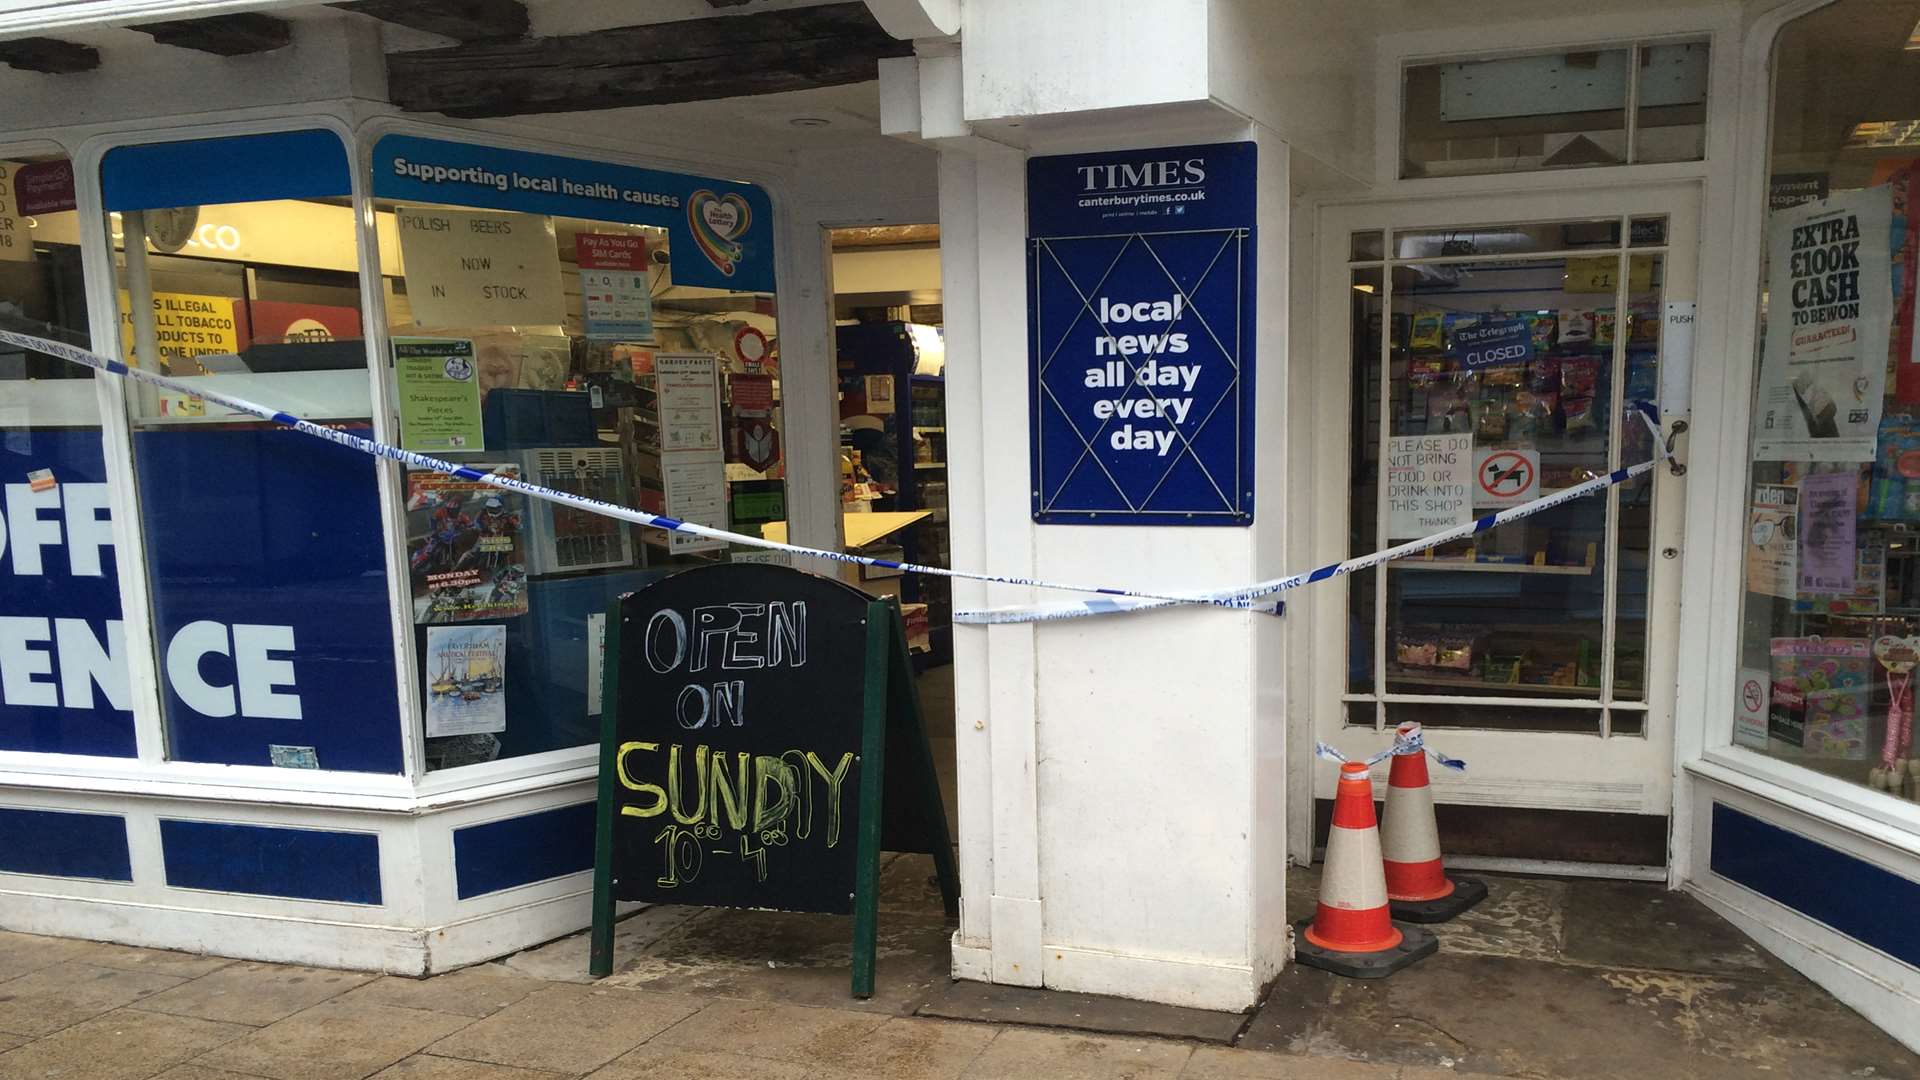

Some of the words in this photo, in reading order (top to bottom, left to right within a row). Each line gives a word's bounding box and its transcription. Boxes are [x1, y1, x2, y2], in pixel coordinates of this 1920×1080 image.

[394, 158, 508, 191] Supporting
[513, 172, 557, 194] local
[562, 179, 618, 201] health
[623, 189, 679, 208] causes
[1078, 158, 1206, 191] TIMES
[1078, 190, 1206, 208] canterburytimes.co.uk
[709, 218, 734, 228] Lottery
[710, 211, 733, 219] Health
[399, 216, 451, 234] POLISH
[470, 218, 511, 235] BEERS
[1791, 214, 1860, 251] EXTRA
[582, 237, 598, 249] Pay
[599, 238, 609, 247] As
[610, 238, 626, 248] You
[627, 240, 639, 248] Go
[608, 249, 633, 259] Cards
[1790, 241, 1860, 280] £100K
[461, 256, 491, 272] NOW
[431, 284, 446, 299] IN
[483, 285, 528, 300] STOCK
[1791, 269, 1860, 309] CASH
[165, 299, 217, 313] ILLEGAL
[1100, 293, 1183, 323] local
[1792, 309, 1811, 326] TO
[1811, 307, 1825, 324] BE
[1825, 303, 1860, 322] WON
[176, 315, 232, 330] TOBACCO
[1670, 314, 1696, 324] PUSH
[156, 330, 205, 343] ODUCTS
[207, 333, 222, 344] TO
[1458, 331, 1478, 342] The
[1480, 321, 1525, 338] Telegraph
[1095, 332, 1189, 356] news
[1466, 344, 1526, 366] CLOSED
[1084, 361, 1124, 388] all
[1136, 360, 1201, 392] day
[409, 394, 468, 403] Shakespeare's
[1093, 397, 1193, 424] every
[298, 421, 337, 442] POLICE
[341, 433, 365, 449] LINE
[368, 440, 384, 455] DO
[387, 446, 410, 462] NOT
[413, 453, 454, 472] CROSS
[1111, 424, 1176, 456] day
[1388, 439, 1441, 453] PLEASE
[1448, 438, 1468, 451] DO
[1388, 454, 1412, 467] NOT
[1416, 452, 1457, 466] BRING
[1388, 471, 1425, 483] FOOD
[1433, 470, 1451, 482] OR
[1388, 484, 1428, 497] DRINK
[1434, 484, 1464, 497] INTO
[1389, 499, 1419, 512] THIS
[1424, 498, 1463, 512] SHOP
[0, 482, 116, 576] FF
[1418, 516, 1457, 527] THANKS
[425, 569, 479, 582] MONDAY
[645, 601, 807, 673] OPEN
[676, 680, 744, 729] ON
[617, 741, 853, 848] SUNDAY
